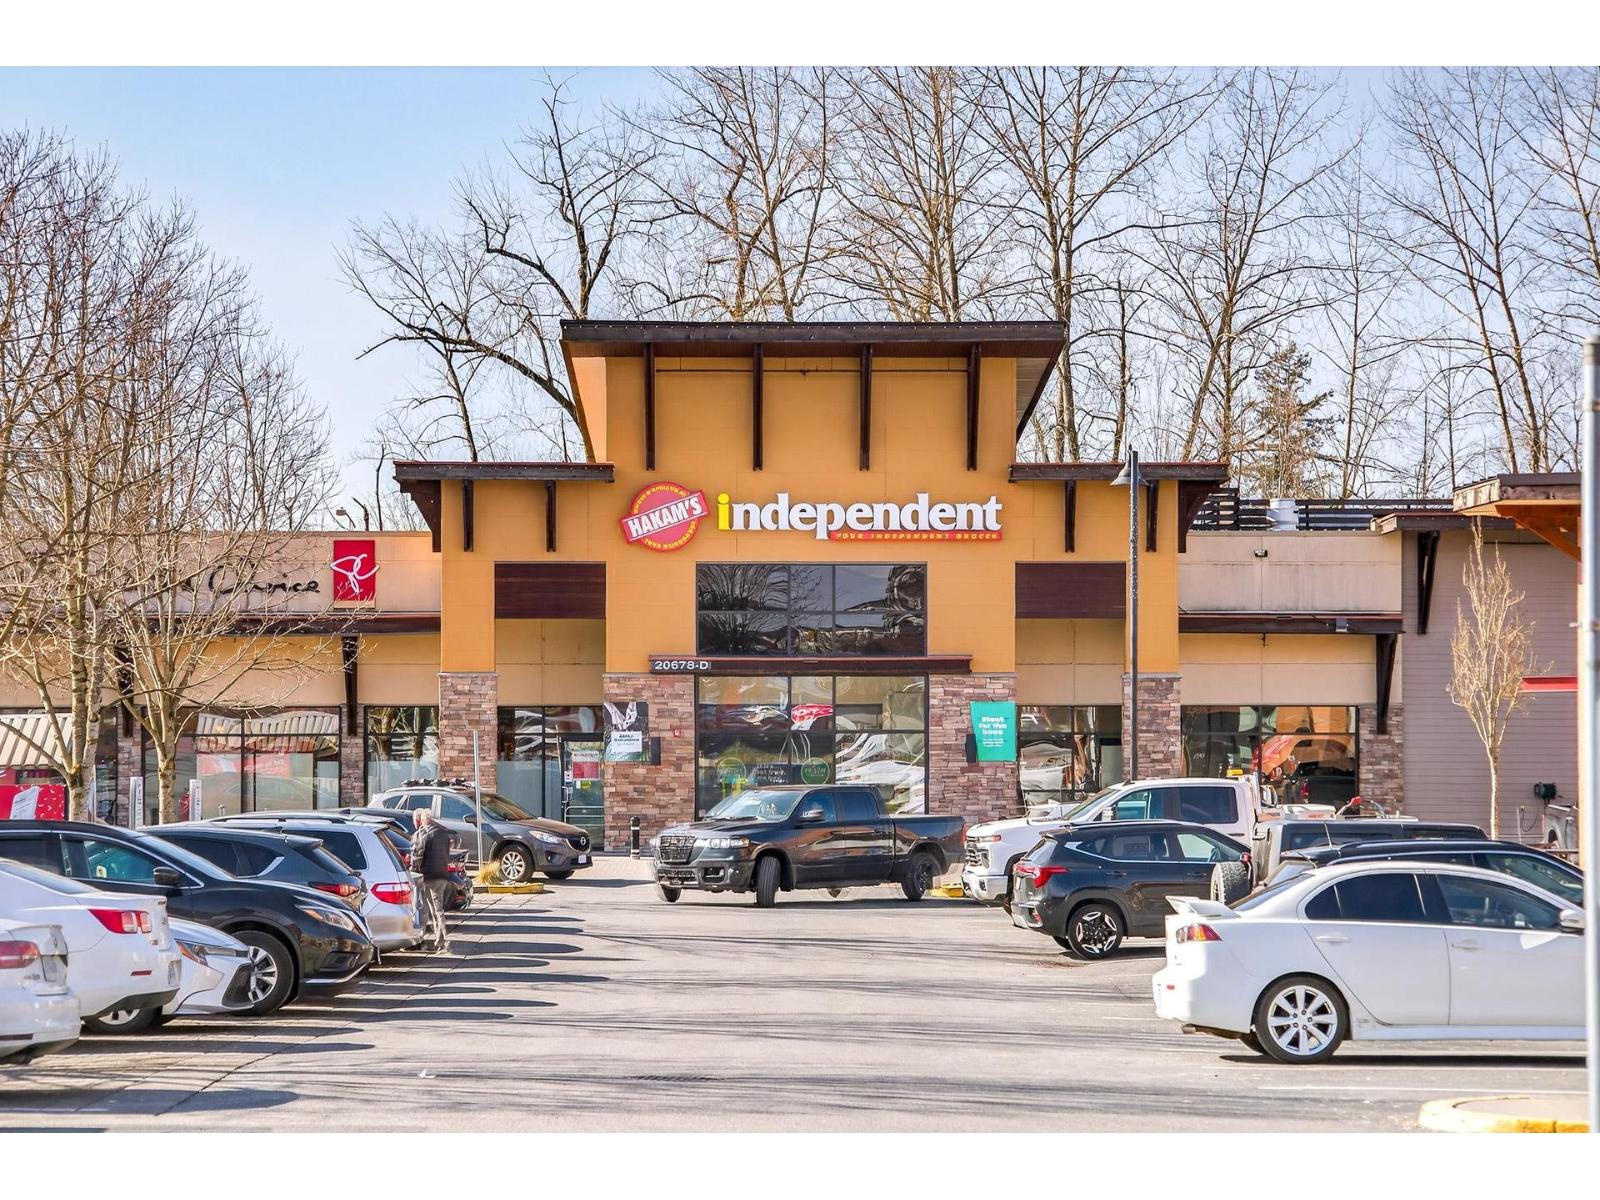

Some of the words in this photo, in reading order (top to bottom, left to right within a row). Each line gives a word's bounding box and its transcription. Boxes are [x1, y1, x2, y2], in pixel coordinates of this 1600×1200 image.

[627, 496, 702, 538] HAKAM'S
[717, 492, 1003, 540] independent
[654, 660, 709, 670] 20678-D
